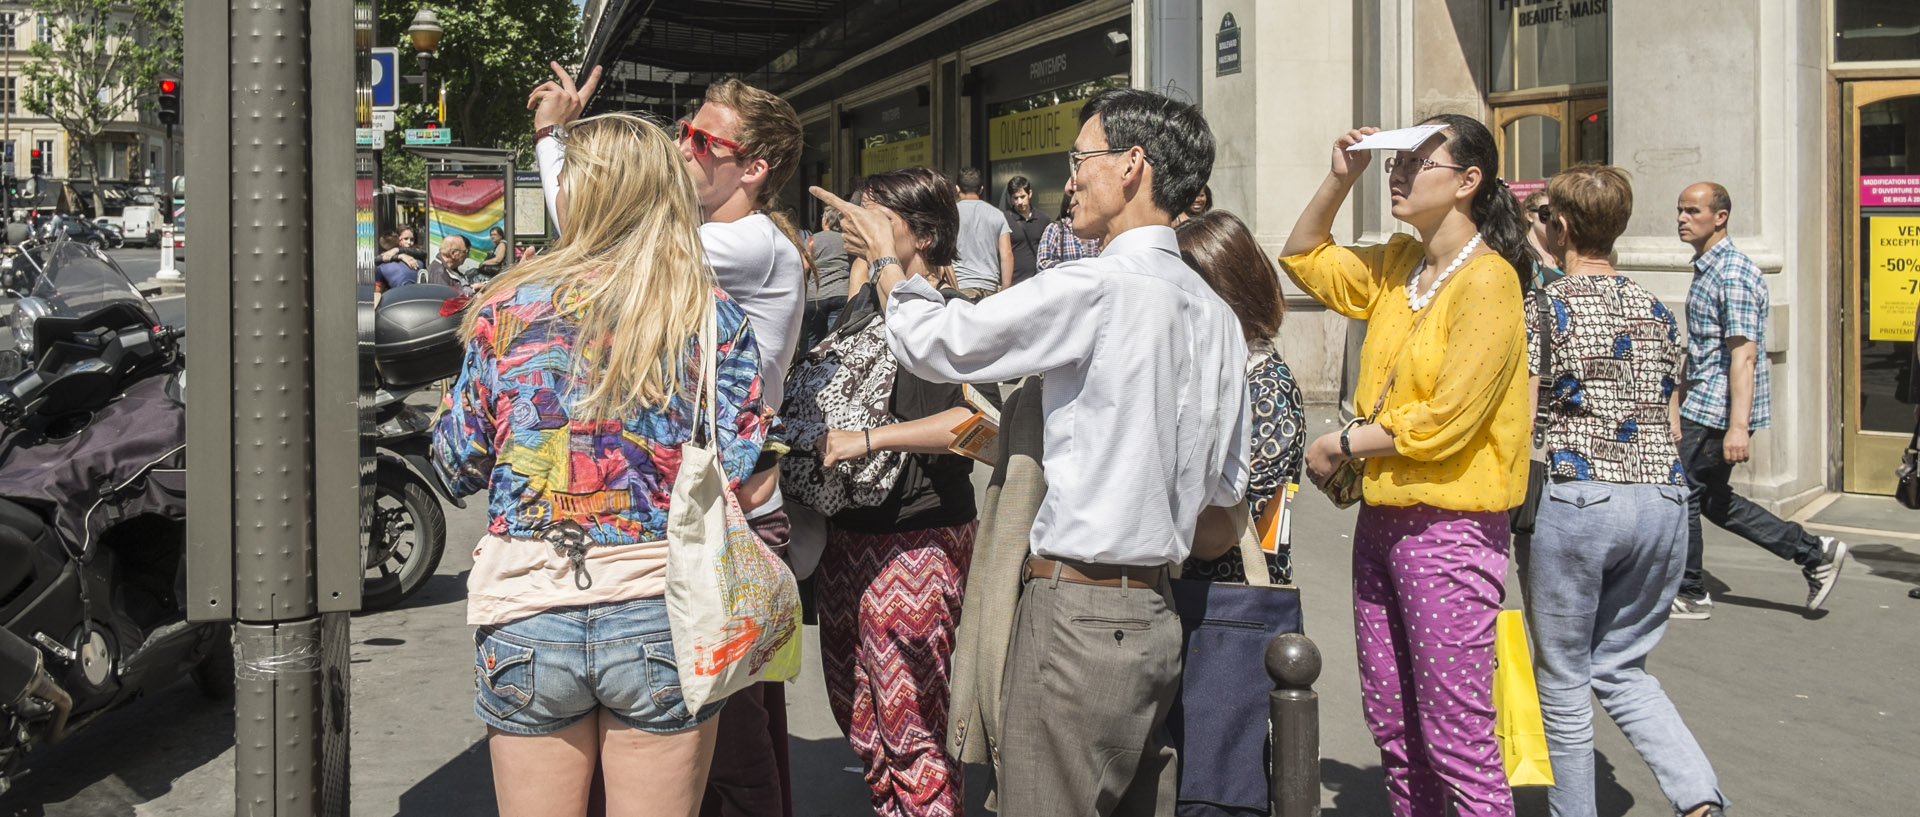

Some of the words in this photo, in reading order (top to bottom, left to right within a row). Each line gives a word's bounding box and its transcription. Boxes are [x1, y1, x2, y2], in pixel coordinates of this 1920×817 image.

[1519, 2, 1562, 27] BEAUTÉ
[1029, 54, 1067, 79] PRINTEMPS
[1001, 111, 1061, 154] OUVERTURE
[1880, 238, 1920, 246] EXCEPTI
[1880, 258, 1920, 272] -50%
[1900, 279, 1920, 294] -7
